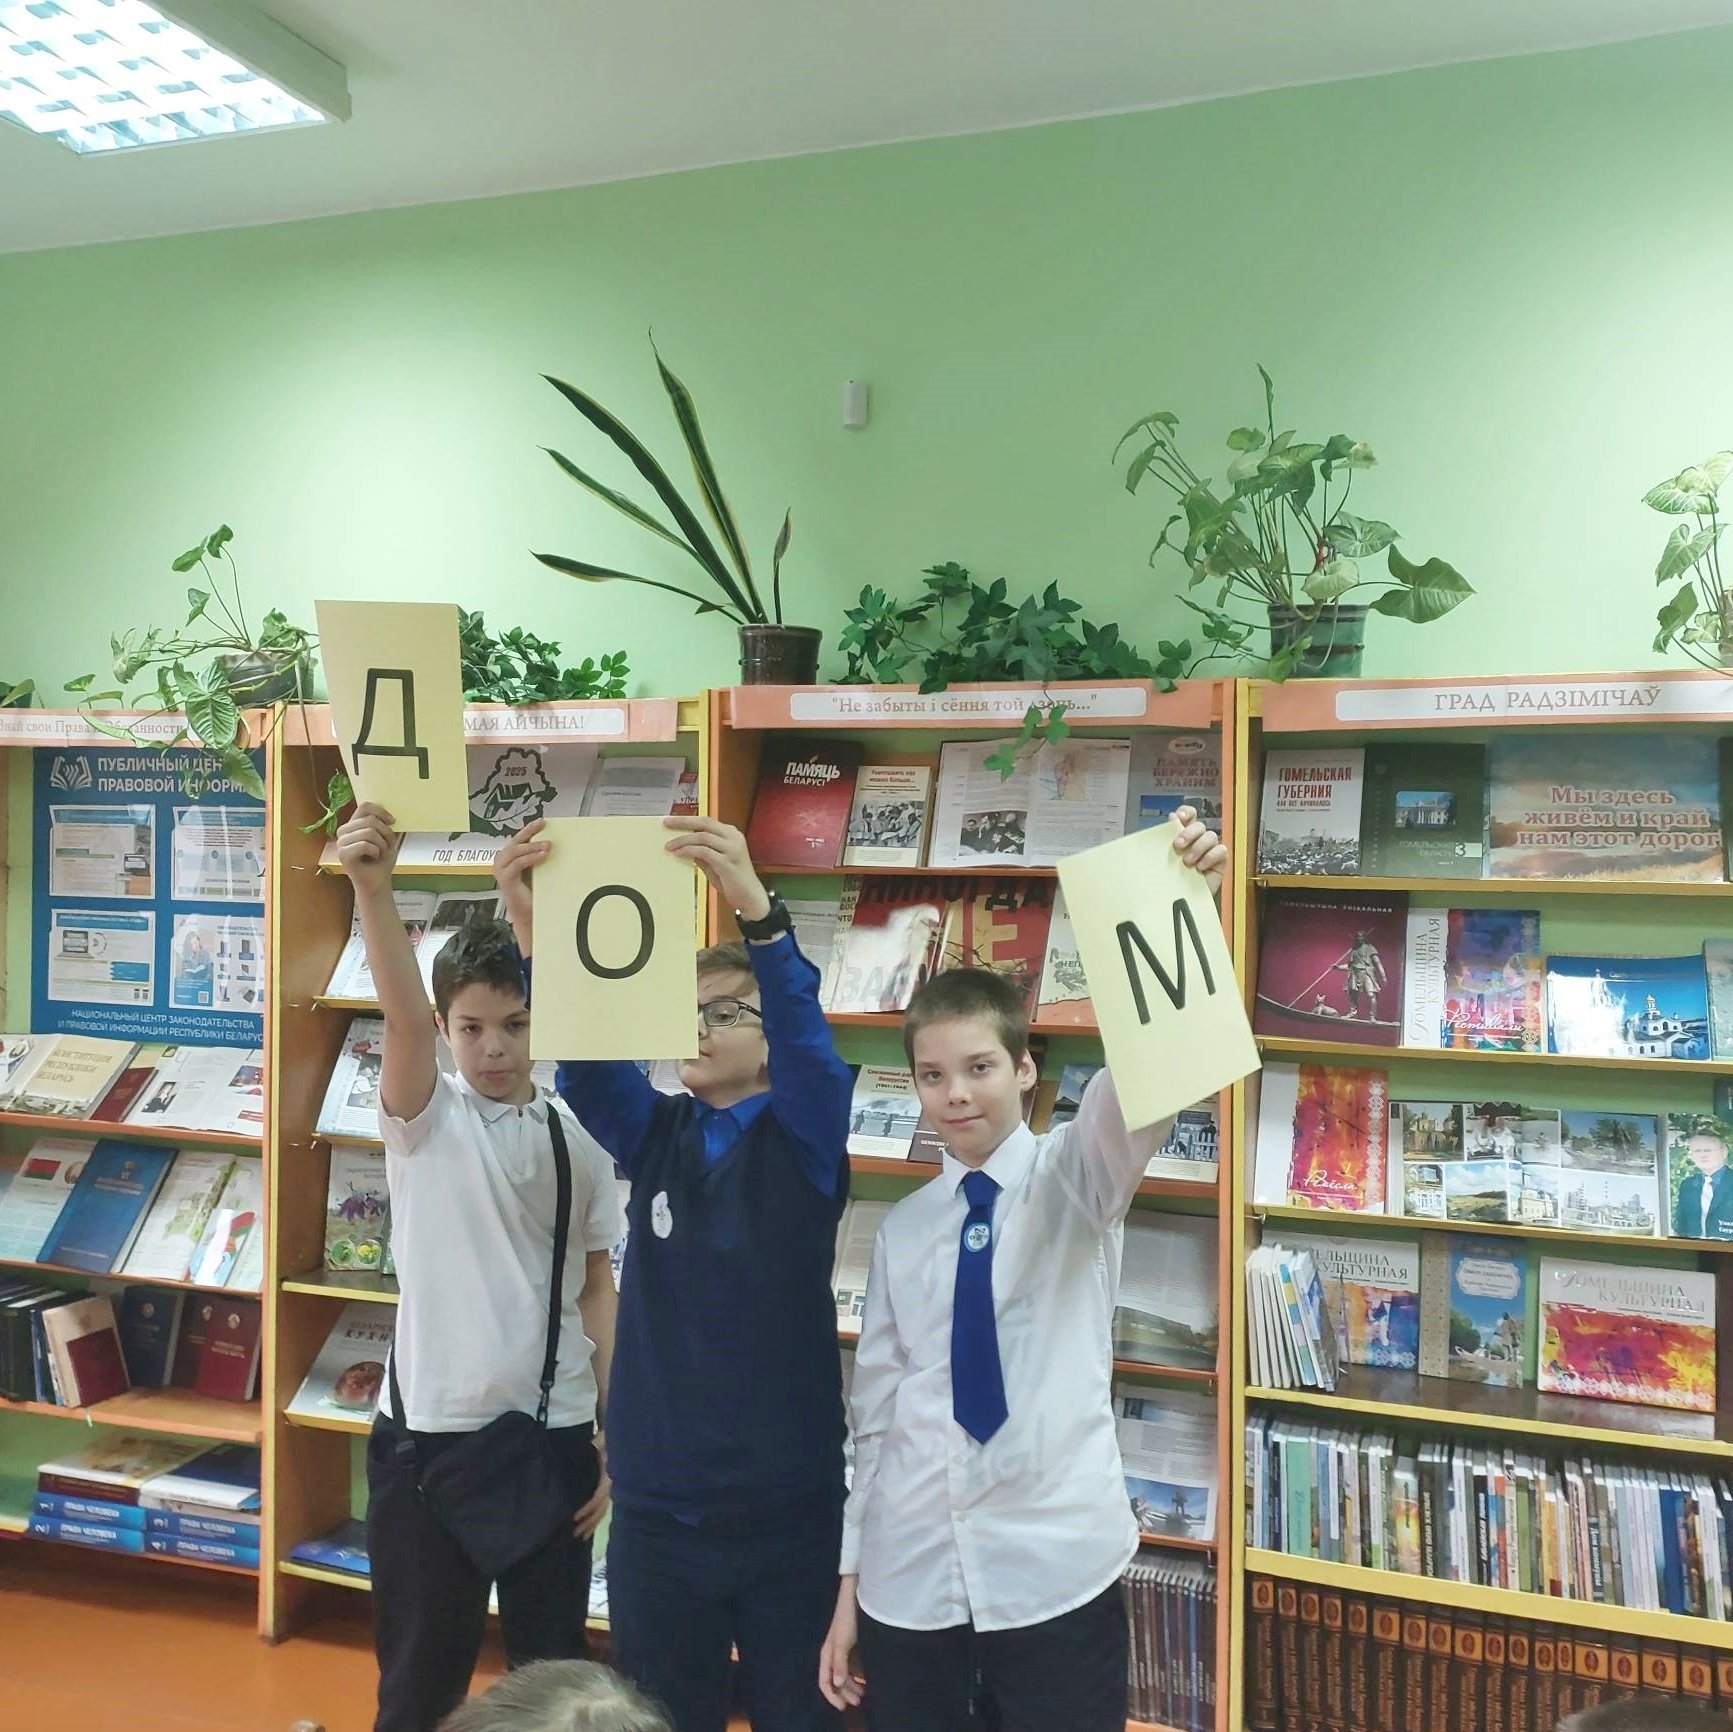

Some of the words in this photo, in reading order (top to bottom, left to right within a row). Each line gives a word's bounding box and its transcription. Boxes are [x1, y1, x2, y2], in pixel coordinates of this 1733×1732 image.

[866, 696, 926, 713] забыты
[941, 697, 990, 712] сёння
[995, 697, 1024, 711] той
[1435, 691, 1495, 712] ГРАД
[1506, 687, 1662, 709] РАДЗІМІЧАЎ
[351, 668, 430, 779] Д
[464, 716, 499, 731] МАЯ
[504, 714, 584, 730] АЙЧЫНА!
[98, 755, 189, 772] ПУБЛИЧНЫЙ
[505, 767, 527, 776] 2025
[785, 762, 841, 781] ПАМЯЦЬ
[783, 776, 826, 787] БЕЛАРУСІ
[1278, 767, 1352, 782] ГОМЕЛЬСКАЯ
[98, 776, 175, 792] ПРАВОВОЙ
[178, 778, 263, 793] ИНОРМ
[1277, 785, 1332, 799] ГУБЕРНИЯ
[1552, 787, 1594, 804] Мы
[1601, 791, 1673, 809] здесь
[1524, 809, 1612, 825] живём
[1619, 813, 1636, 825] и
[1641, 810, 1709, 830] край
[1519, 832, 1570, 845] нам
[1576, 832, 1633, 845] этот
[432, 850, 453, 863] ГОД
[457, 850, 499, 862] БЛАГОУ
[1455, 843, 1466, 856] 3
[575, 884, 656, 980] О
[1115, 897, 1217, 1026] М
[1428, 918, 1440, 1003] КУЛЬТУРНАЯ
[71, 1008, 139, 1021] НАЦИОНАЛЬНЫЙ
[140, 1014, 167, 1024] ЦЕНТР
[168, 1015, 255, 1030] ЗАКОНОДАТЕЛЬСТВА
[168, 1028, 225, 1040] РЕСПУБЛИКИ
[225, 1031, 264, 1043] БЕЛАРУС
